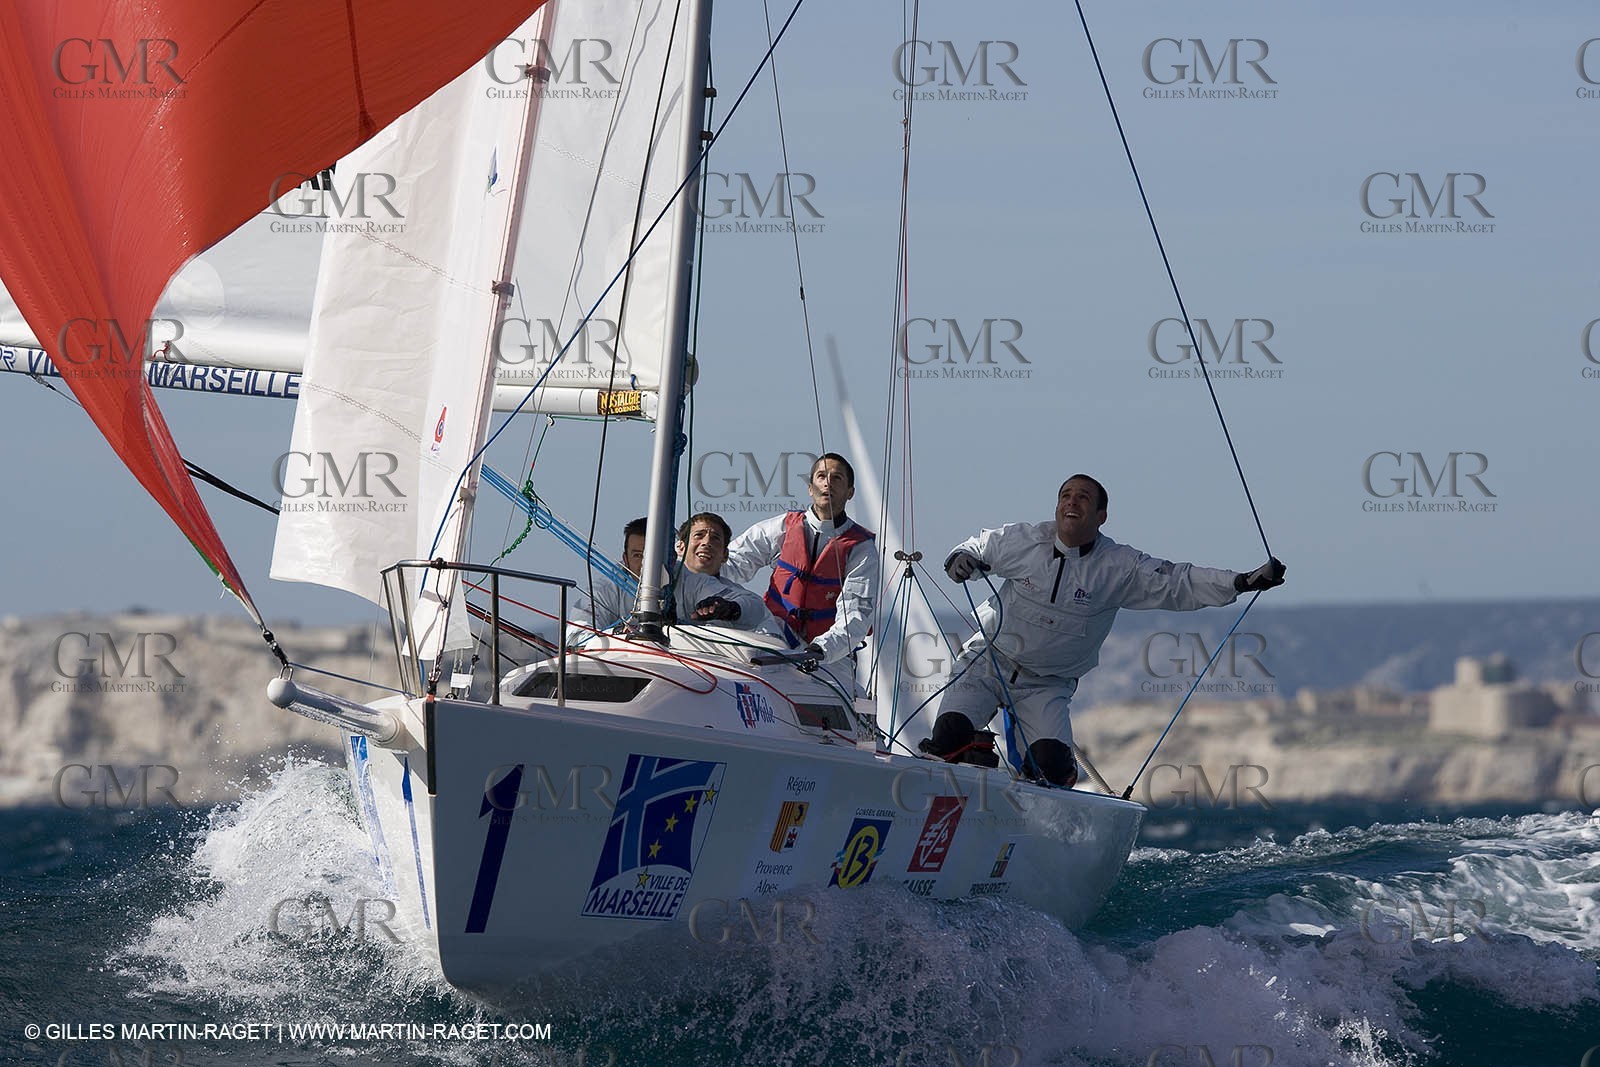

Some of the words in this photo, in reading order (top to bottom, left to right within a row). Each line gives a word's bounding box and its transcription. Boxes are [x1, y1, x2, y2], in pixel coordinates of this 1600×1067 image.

[148, 362, 302, 398] MARSEILLE
[786, 776, 817, 796] Région
[464, 763, 526, 934] 1
[754, 860, 793, 877] Provence
[649, 876, 674, 890] VILLE
[674, 877, 690, 891] DE
[588, 888, 684, 918] MARSEILLE
